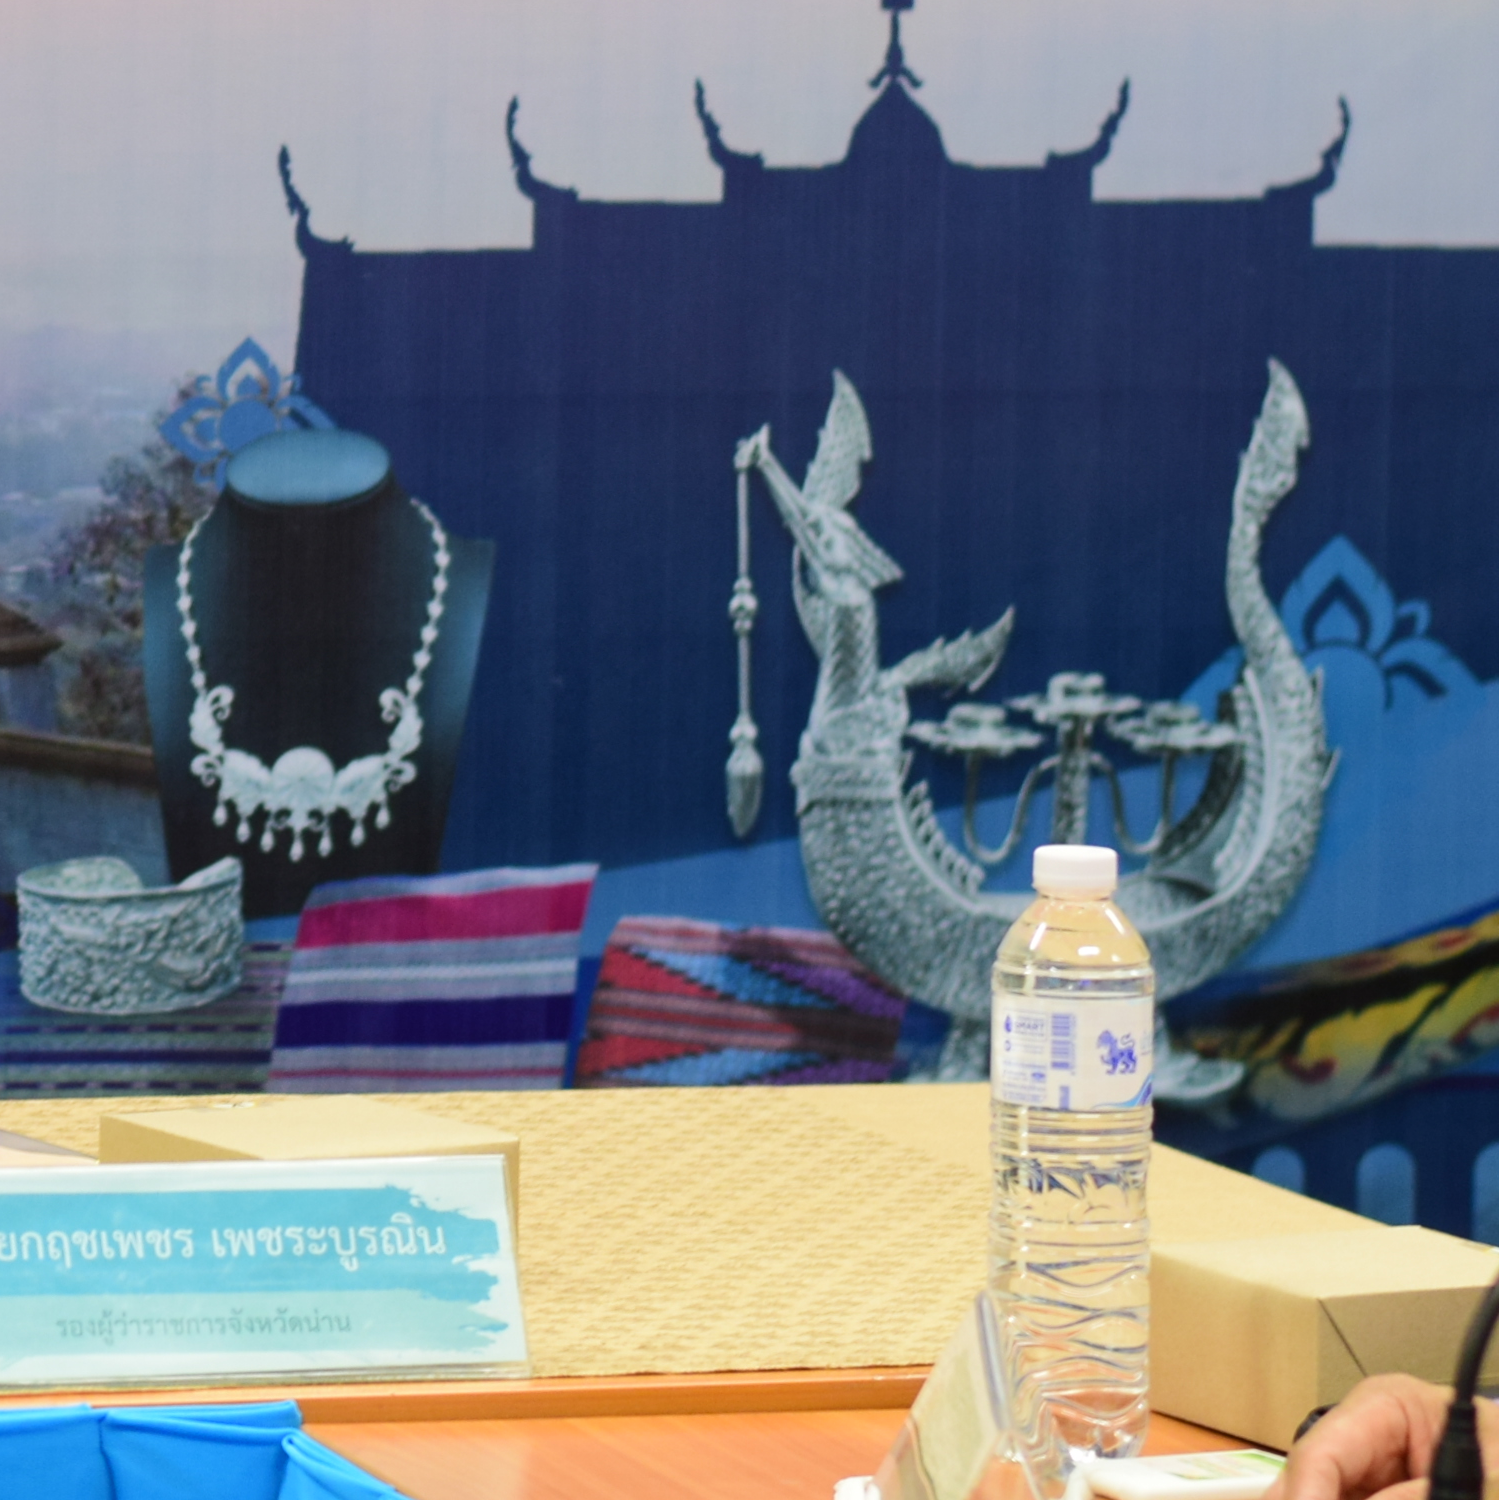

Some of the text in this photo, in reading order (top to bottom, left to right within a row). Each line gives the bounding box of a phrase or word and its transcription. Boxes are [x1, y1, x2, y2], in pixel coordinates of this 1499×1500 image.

[210, 1211, 448, 1272] เพชระบูรณิน
[55, 1304, 352, 1347] รองผู้ว่าราชการจังหวัดน่าน
